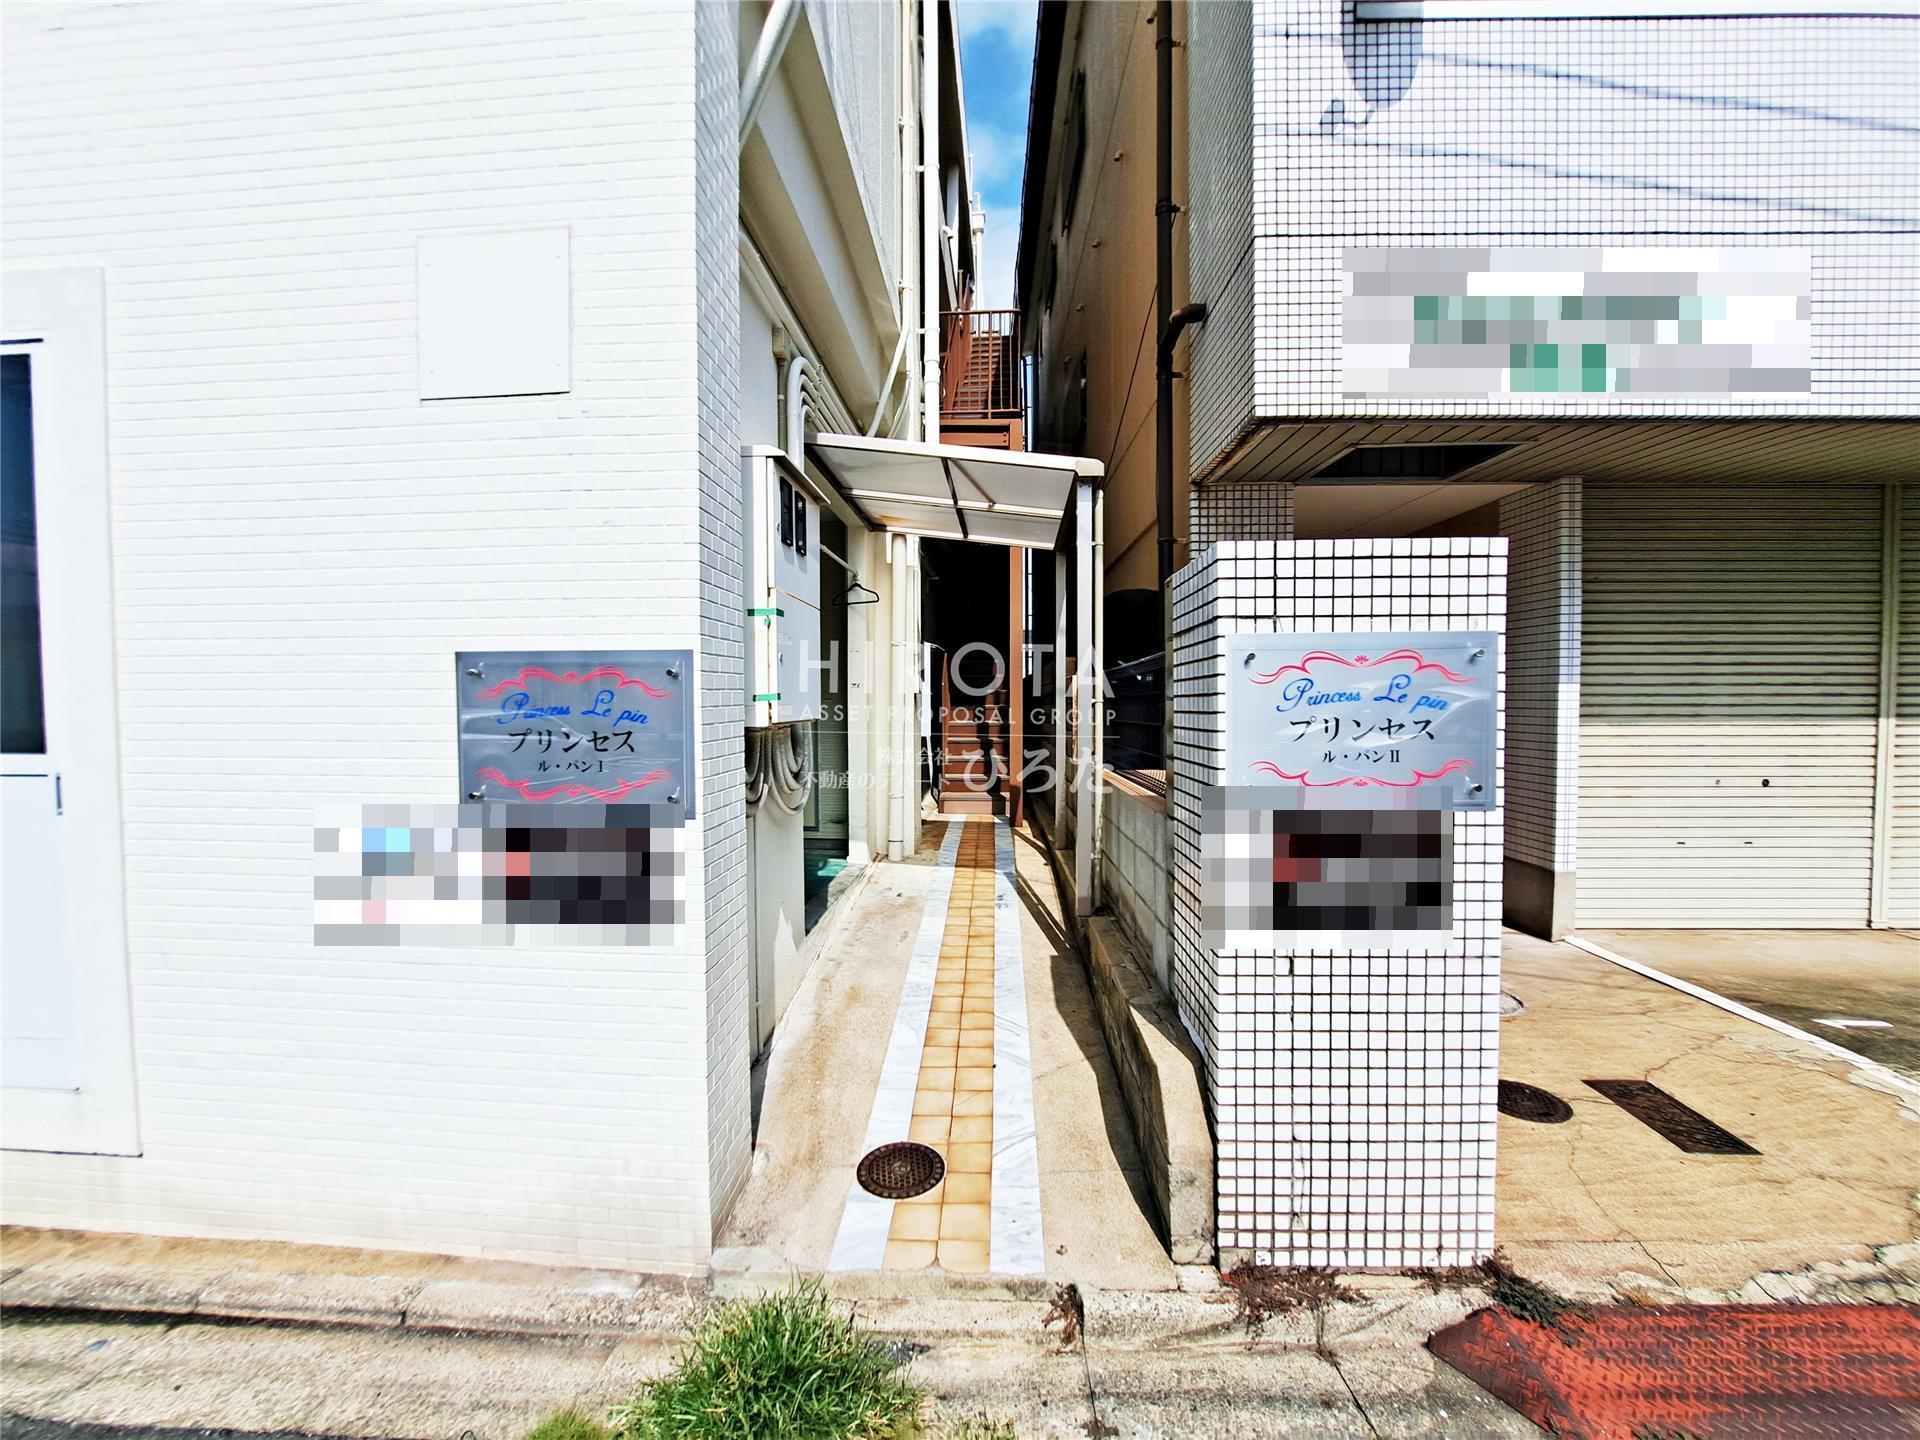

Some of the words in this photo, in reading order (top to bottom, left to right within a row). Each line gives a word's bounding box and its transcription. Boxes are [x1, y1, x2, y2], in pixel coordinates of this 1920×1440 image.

[581, 689, 615, 717] Le
[612, 709, 648, 728] pin
[1276, 678, 1360, 712] Princess
[1374, 674, 1411, 703] Le
[1409, 695, 1448, 713] pin
[508, 727, 635, 753] プリンセス
[1290, 715, 1435, 743] プリンセス
